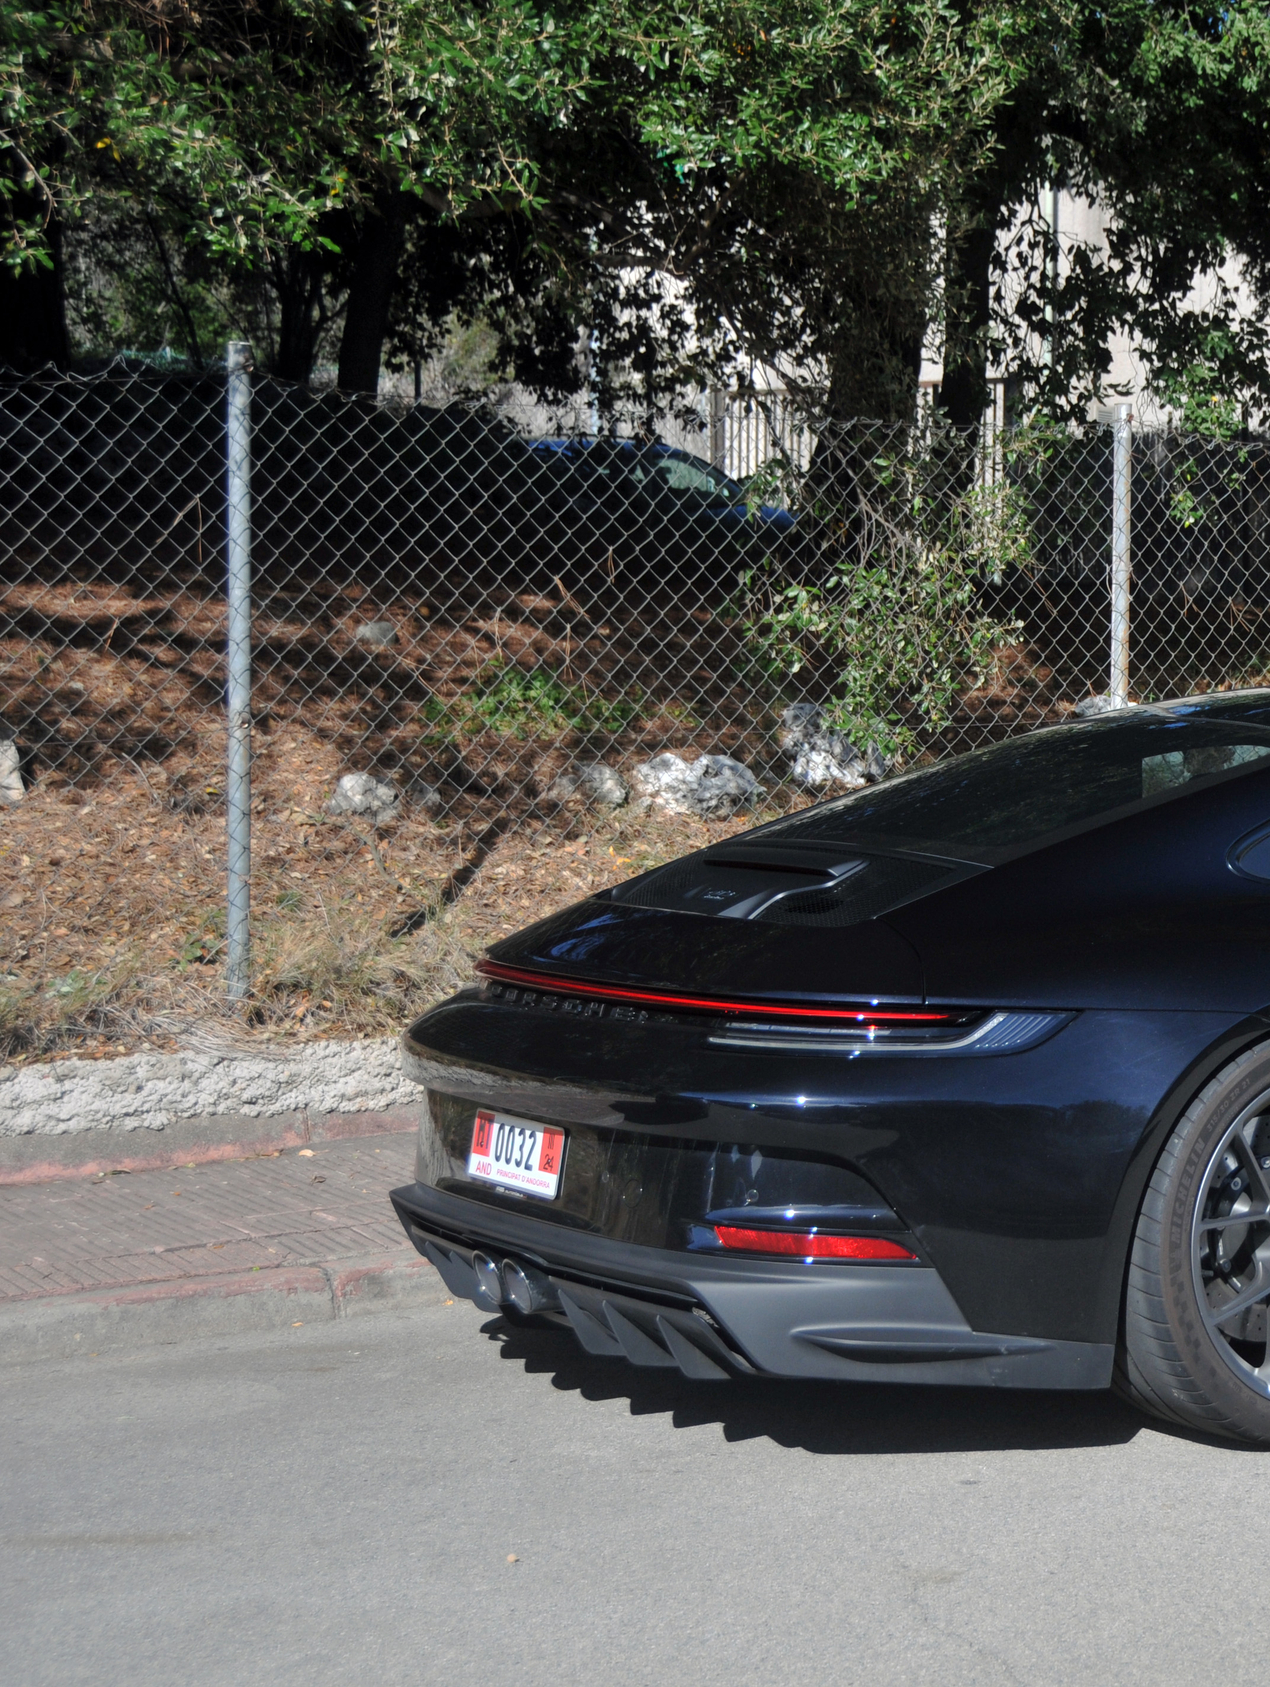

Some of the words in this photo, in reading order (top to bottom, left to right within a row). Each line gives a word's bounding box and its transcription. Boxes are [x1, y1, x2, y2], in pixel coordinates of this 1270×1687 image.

[1207, 1100, 1230, 1132] 315/30
[1230, 1089, 1241, 1103] ZR
[1242, 1078, 1251, 1089] 21
[494, 1123, 537, 1172] 0032
[543, 1153, 554, 1171] 24
[475, 1160, 492, 1175] AND
[496, 1169, 521, 1181] PRINCIPAT
[521, 1175, 550, 1189] D'ANDORRA
[1171, 1138, 1205, 1244] MICHELIN
